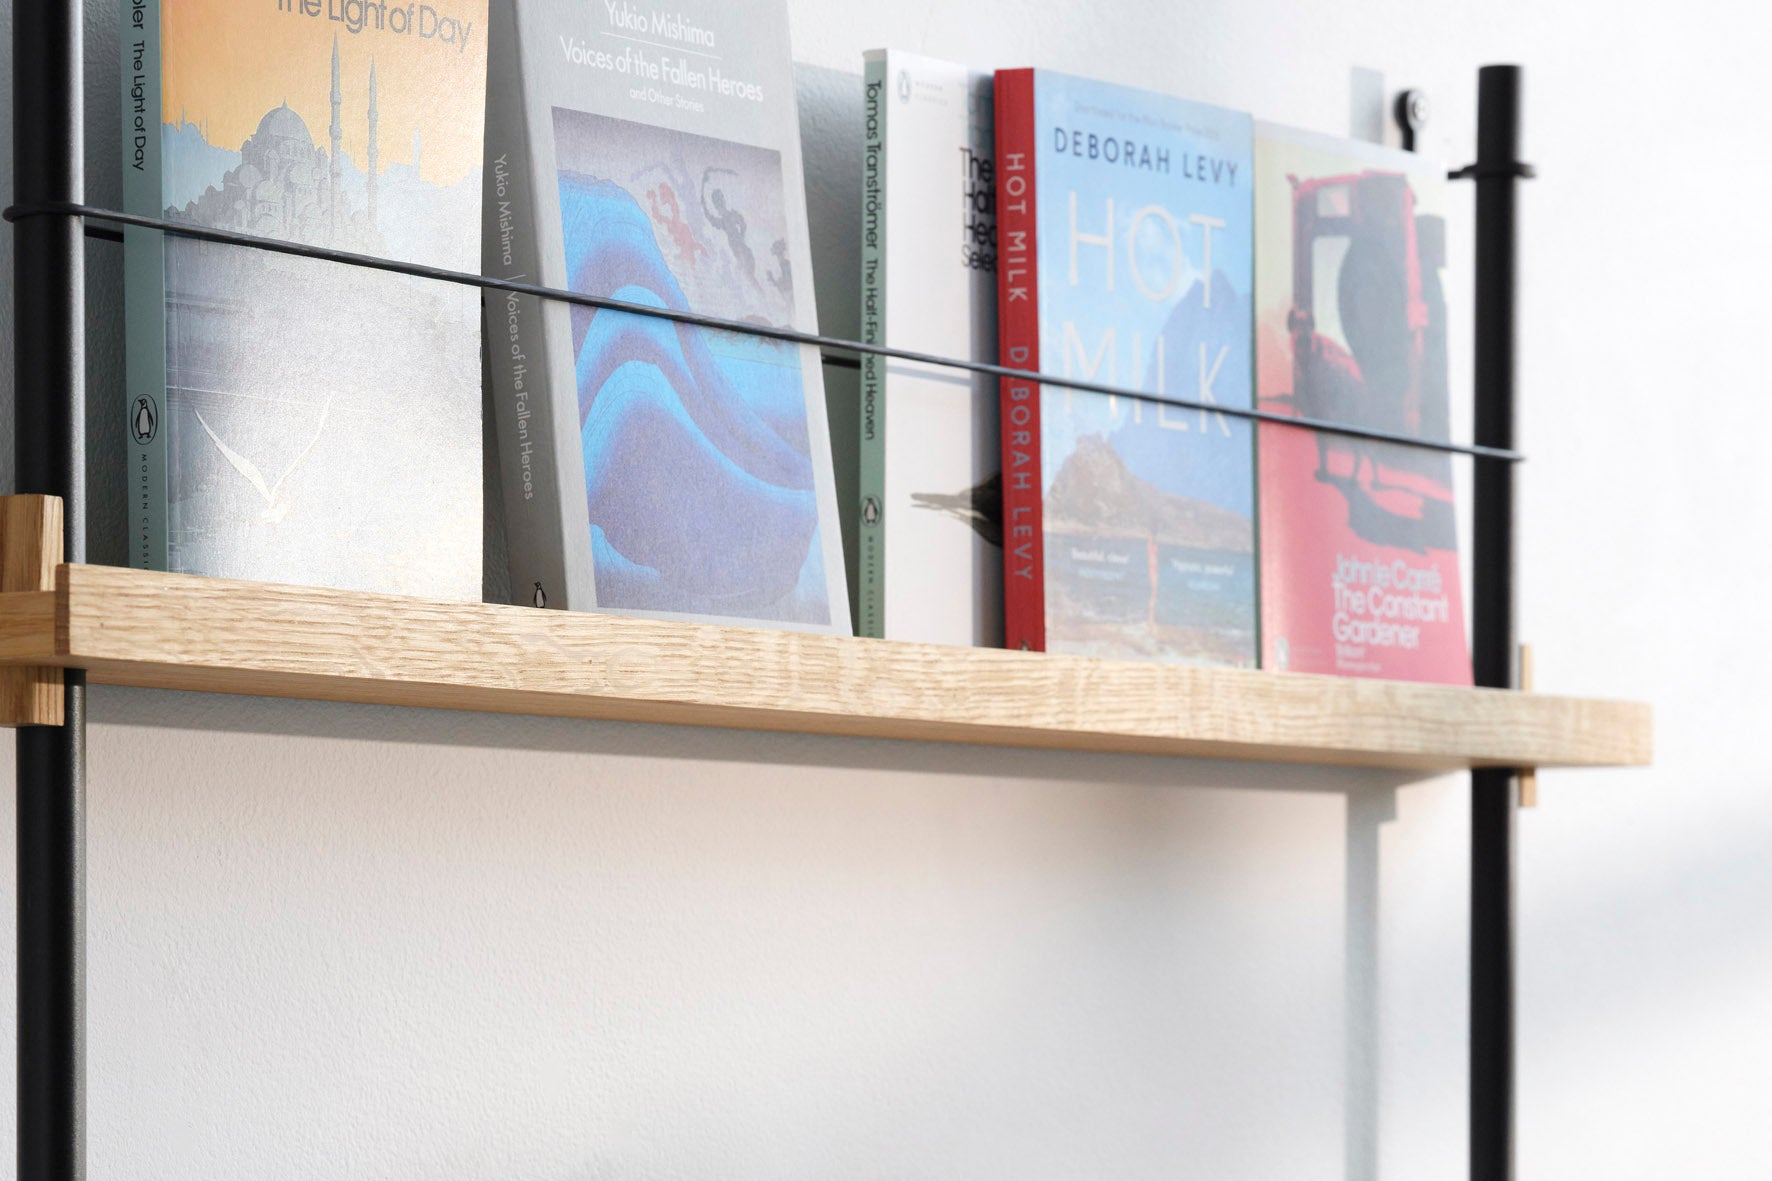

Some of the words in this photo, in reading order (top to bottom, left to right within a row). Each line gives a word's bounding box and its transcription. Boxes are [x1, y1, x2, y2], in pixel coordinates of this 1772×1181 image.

[329, 0, 388, 35] Light
[389, 1, 417, 36] of
[420, 5, 473, 53] Day
[604, 1, 648, 33] Yukio
[651, 11, 716, 48] Mishima
[133, 40, 145, 71] The
[559, 36, 613, 73] Voices
[616, 47, 634, 74] of
[633, 52, 660, 81] the
[661, 56, 706, 92] Fallen
[708, 67, 764, 103] Heroes
[131, 75, 146, 114] Light
[629, 86, 647, 100] and
[866, 80, 882, 138] Tomas
[133, 116, 146, 133] of
[132, 136, 146, 172] Day
[494, 153, 510, 197] Yukio
[959, 147, 993, 182] The
[1054, 126, 1171, 175] DEBORAH
[1183, 152, 1239, 188] LEVY
[866, 141, 882, 250] Tranströmer
[1005, 153, 1027, 214] HOT
[498, 201, 514, 266] Mishima
[1068, 190, 1227, 310] HOT
[866, 258, 879, 285] The
[1007, 231, 1028, 302] MILK
[506, 291, 521, 342] Voices
[511, 344, 526, 360] of
[513, 364, 528, 391] the
[1064, 320, 1232, 439] MILK
[515, 391, 531, 441] Fallen
[865, 384, 878, 441] Heaven
[1010, 346, 1031, 490] DBORAH
[141, 453, 149, 510] MODERN
[520, 441, 534, 500] Heroes
[142, 517, 150, 570] CLASSI
[1012, 507, 1034, 581] LEVY
[1332, 582, 1367, 616] The
[1367, 585, 1449, 623] Constant
[1333, 611, 1420, 649] Gardener
